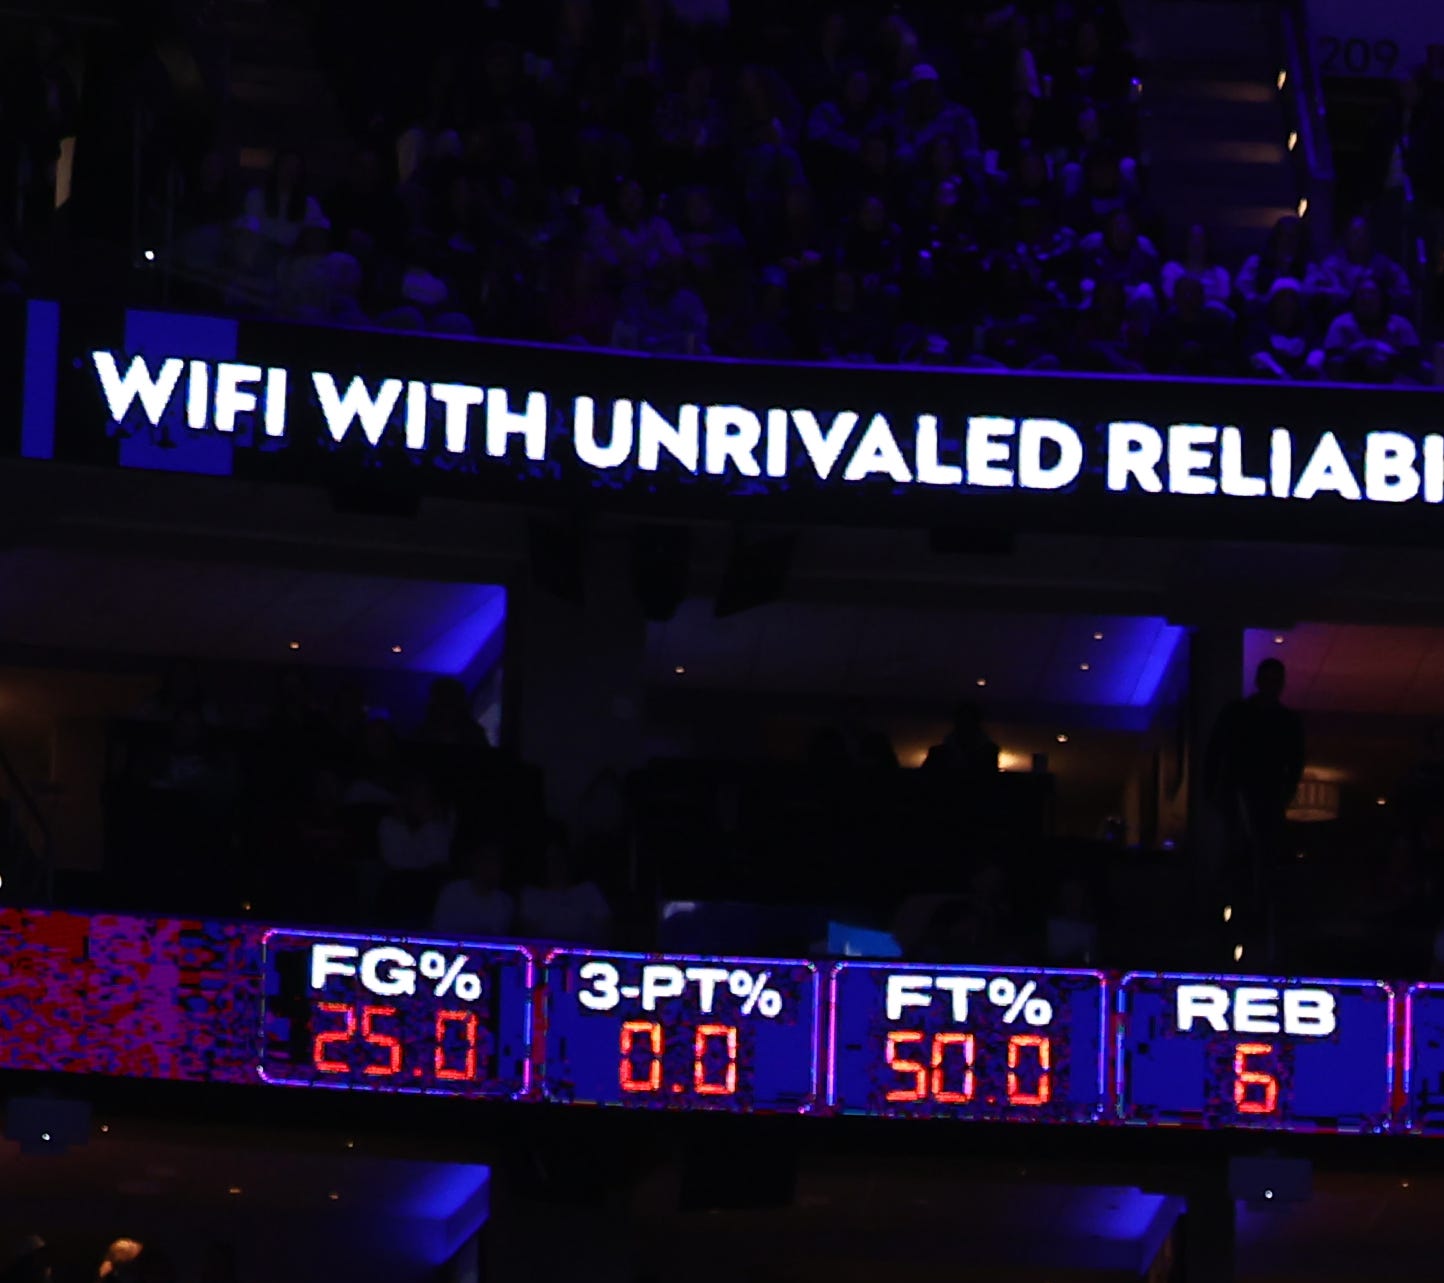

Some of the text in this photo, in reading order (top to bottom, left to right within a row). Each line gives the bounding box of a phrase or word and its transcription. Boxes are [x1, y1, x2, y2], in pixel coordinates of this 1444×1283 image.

[93, 350, 288, 437] WIFI
[311, 371, 548, 461] WITH
[573, 395, 1084, 490] UNRIVALED
[310, 943, 482, 1003] FG%
[578, 961, 783, 1018] 3-PT%
[886, 974, 1053, 1026] FT%
[313, 1003, 478, 1081] 25.0
[1176, 984, 1337, 1036] REB
[618, 1021, 738, 1096] 0.0
[885, 1030, 1051, 1106] 50.0
[1233, 1042, 1278, 1114] 6
